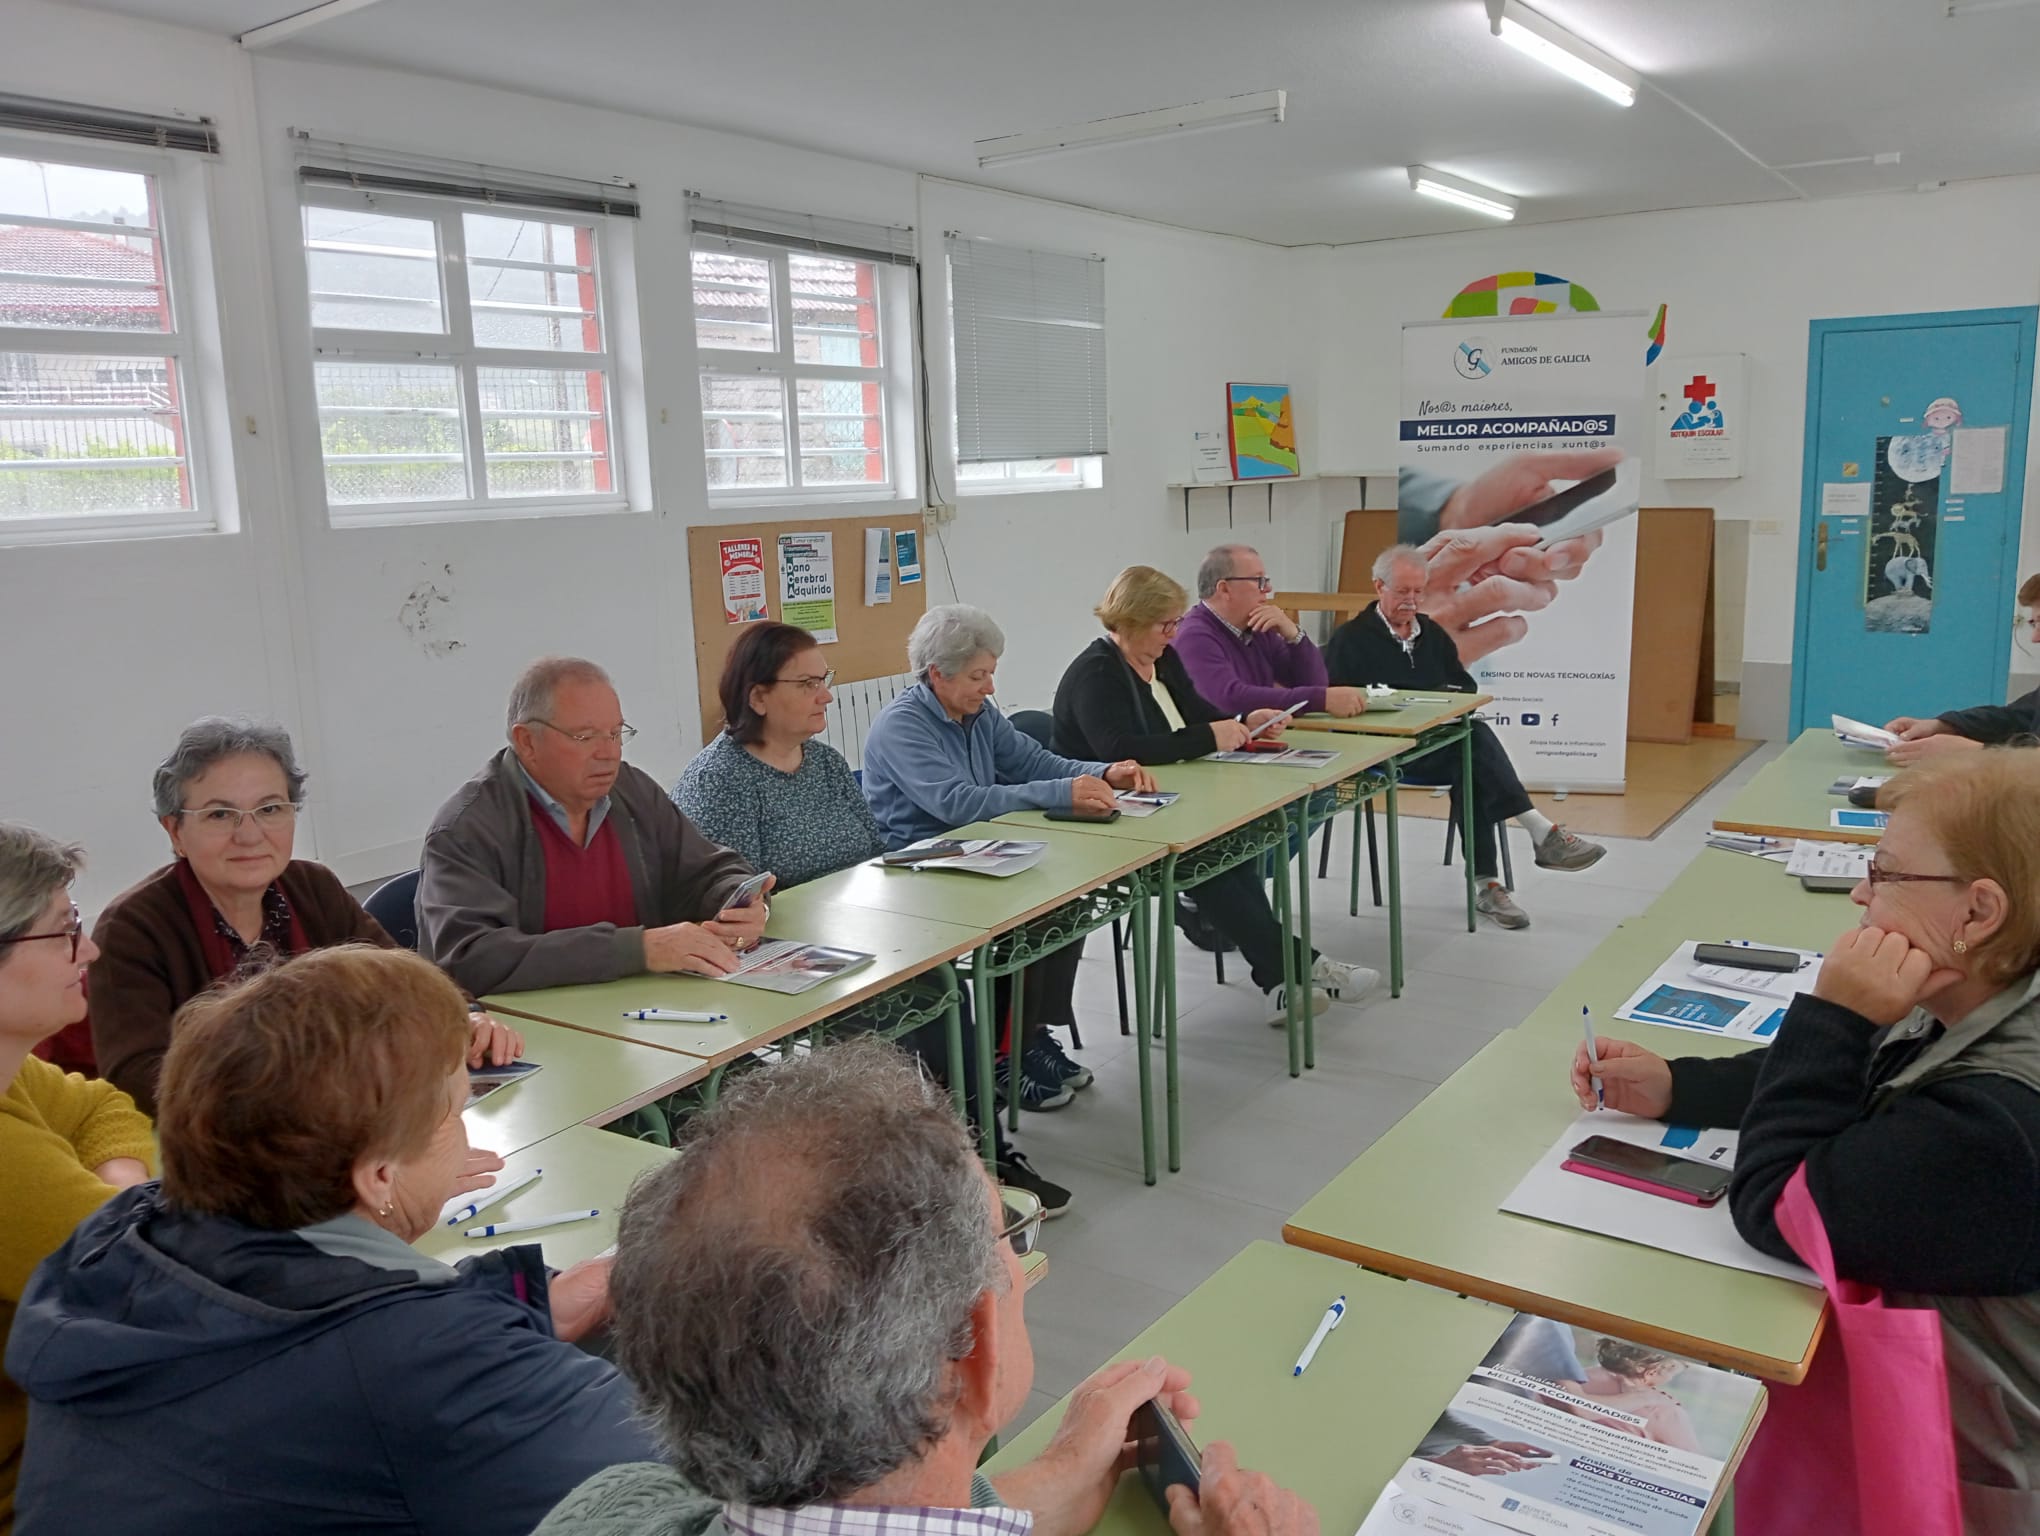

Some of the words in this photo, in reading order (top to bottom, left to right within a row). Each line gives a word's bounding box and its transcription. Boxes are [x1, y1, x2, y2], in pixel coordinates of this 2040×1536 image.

[1501, 356, 1538, 365] AMIGOS
[1540, 356, 1552, 364] DE
[1554, 354, 1590, 364] GALICIA
[1418, 400, 1456, 416] Nos@s
[1461, 400, 1513, 413] maiores,
[1417, 424, 1477, 437] MELLOR
[1481, 418, 1608, 435] ACOMPAÑAD@S
[1417, 444, 1470, 452] Sumando
[1478, 442, 1553, 451] experiencias
[1562, 440, 1606, 449] xunt@s
[724, 544, 750, 554] TALLERES
[788, 563, 810, 572] Dano
[788, 573, 827, 584] Cerebral
[788, 584, 832, 597] Adquirido
[1558, 672, 1616, 680] TECNOLOXÍAS
[1486, 1370, 1536, 1388] MELLOR
[1538, 1386, 1640, 1423] ACOMPAÑAD@S
[1512, 1399, 1563, 1418] Programa
[1564, 1416, 1579, 1424] de
[1579, 1423, 1668, 1454] acompañamento
[1579, 1455, 1616, 1470] Ensino
[1618, 1467, 1632, 1475] de
[1575, 1462, 1614, 1477] NOVAS
[1615, 1474, 1696, 1503] TECNOLOXÍAS
